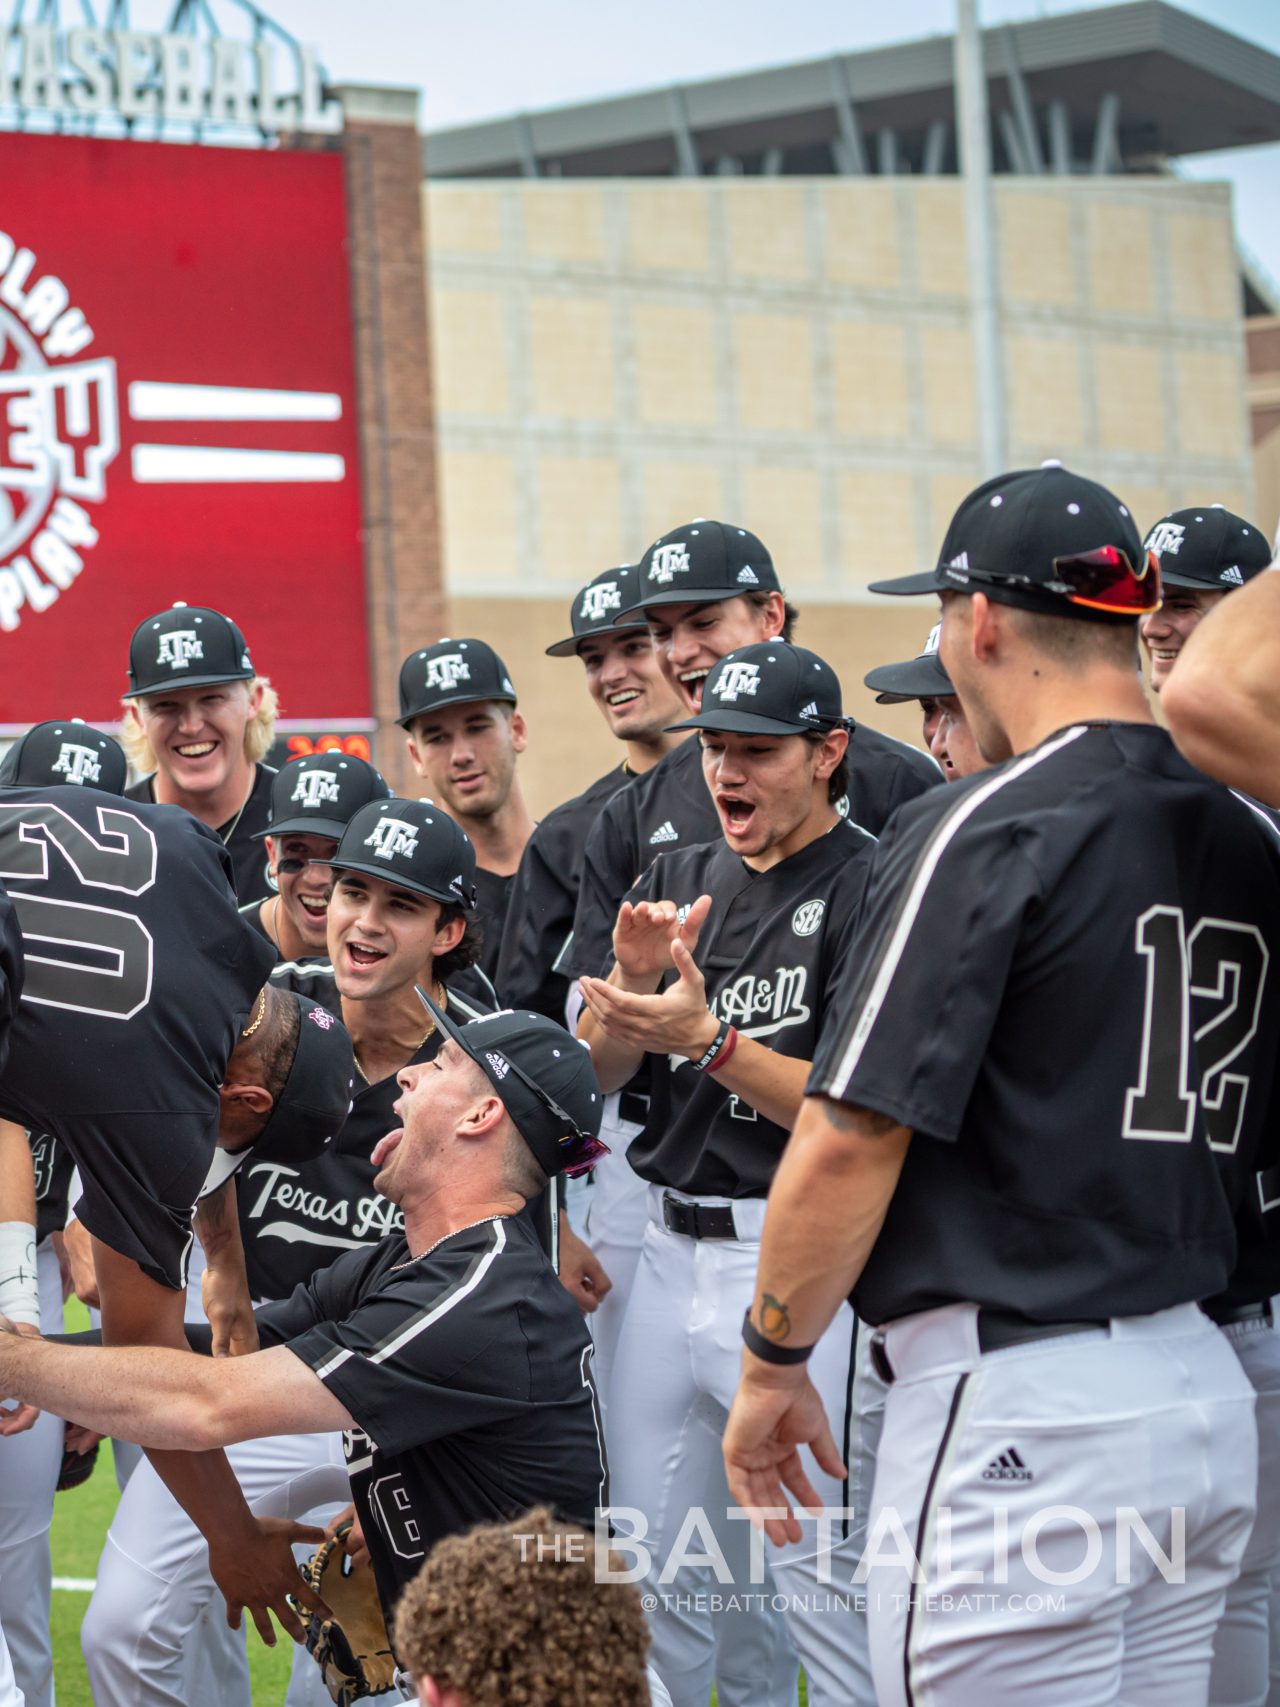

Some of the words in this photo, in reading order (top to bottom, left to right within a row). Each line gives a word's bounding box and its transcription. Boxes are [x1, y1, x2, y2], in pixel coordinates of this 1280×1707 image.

[1122, 904, 1269, 1154] 12
[248, 1163, 349, 1226] Texas
[982, 1468, 1033, 1482] adidas
